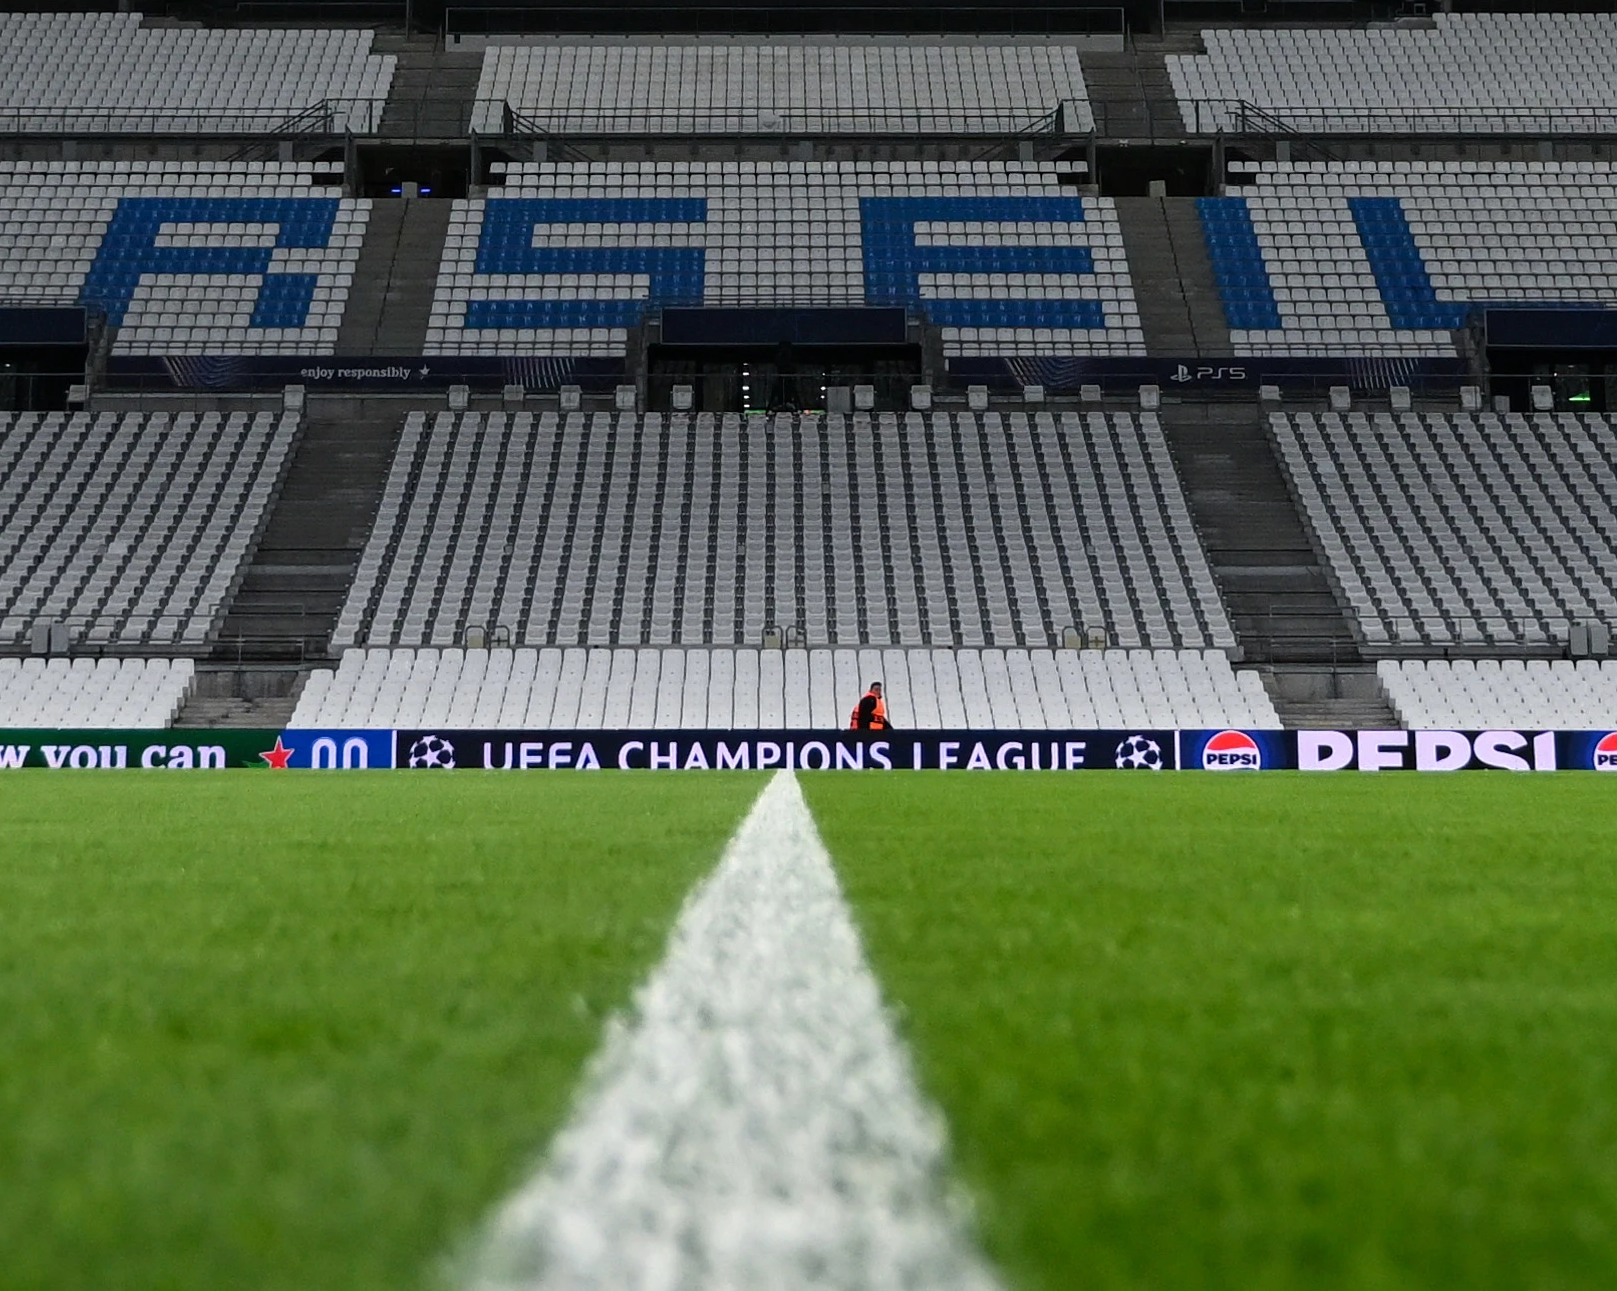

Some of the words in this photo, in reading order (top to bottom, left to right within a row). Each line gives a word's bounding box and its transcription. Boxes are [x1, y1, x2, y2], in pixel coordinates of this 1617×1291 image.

[300, 367, 335, 380] enjoy
[337, 366, 411, 380] responsibly
[1196, 367, 1247, 379] PS5
[42, 744, 129, 768] you
[141, 744, 227, 768] can
[483, 741, 594, 769] UEFA
[618, 741, 891, 769] CHAMPIONS
[913, 741, 1086, 770] LEAGUE
[1206, 753, 1258, 765] PEPSI
[1297, 730, 1557, 770] PEPSI
